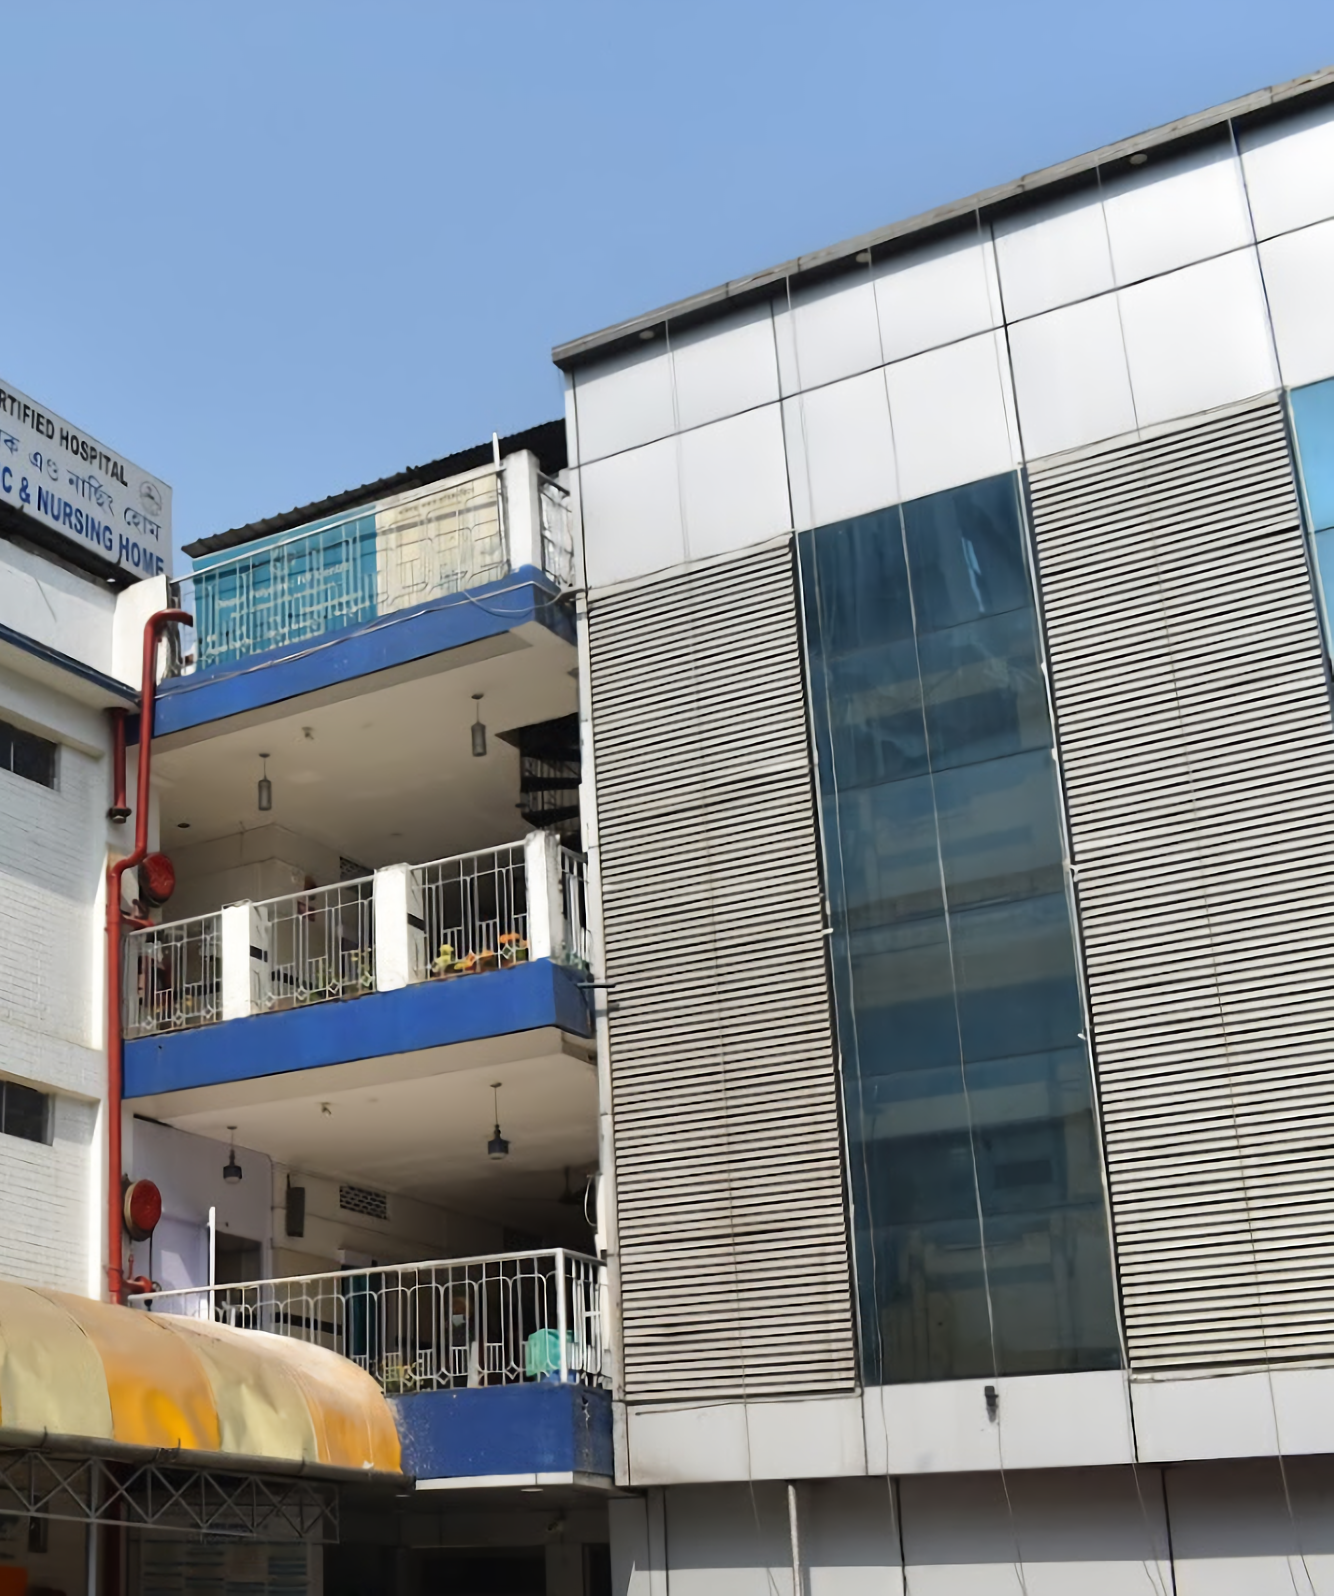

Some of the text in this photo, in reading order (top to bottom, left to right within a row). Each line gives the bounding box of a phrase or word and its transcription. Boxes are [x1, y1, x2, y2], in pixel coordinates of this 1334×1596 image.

[59, 426, 129, 488] HOSPITAL
[18, 476, 31, 505] &
[37, 485, 114, 552] NURSING
[118, 533, 165, 578] HOME
